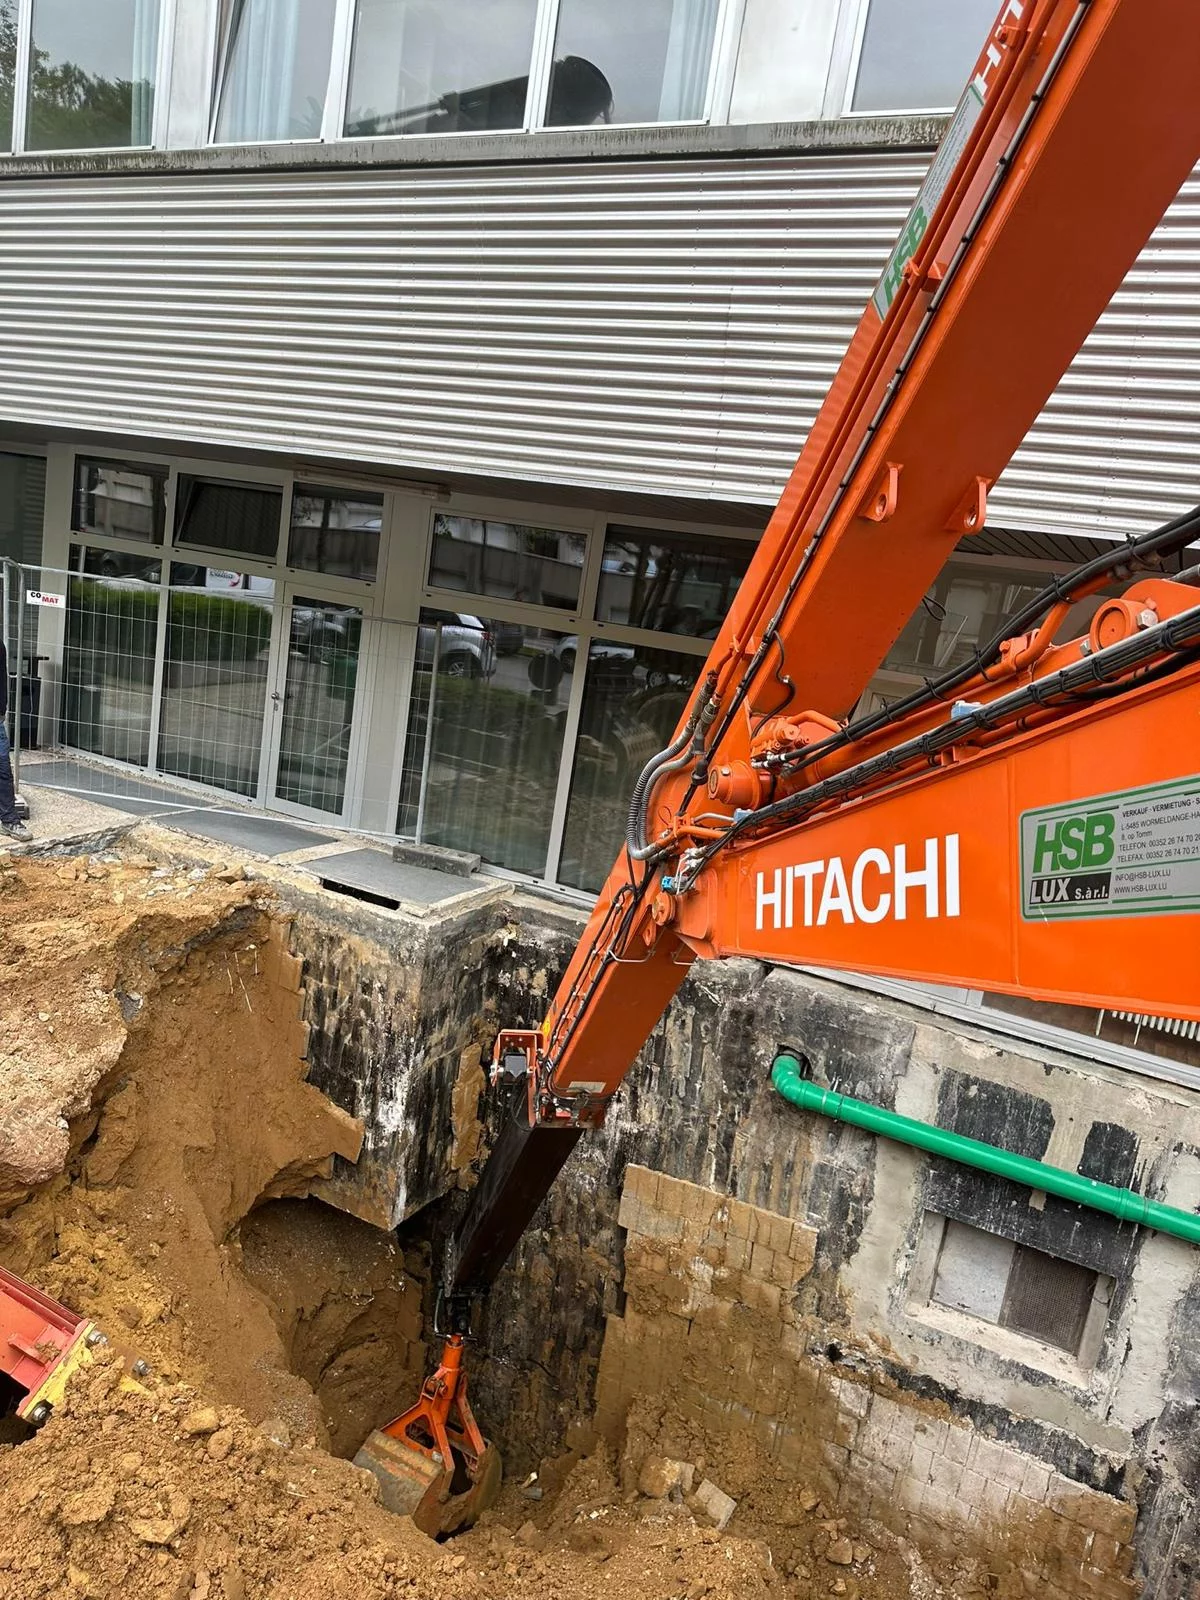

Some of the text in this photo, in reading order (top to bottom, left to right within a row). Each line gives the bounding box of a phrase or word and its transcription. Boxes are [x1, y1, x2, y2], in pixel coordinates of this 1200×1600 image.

[1122, 806, 1149, 818] VERKAUF
[1152, 799, 1191, 812] VERMIETUNG
[1032, 812, 1116, 873] HSB
[1148, 838, 1166, 847] 00352
[1145, 850, 1163, 859] 00352
[756, 833, 960, 929] HITACHI
[1031, 878, 1071, 903] LUX
